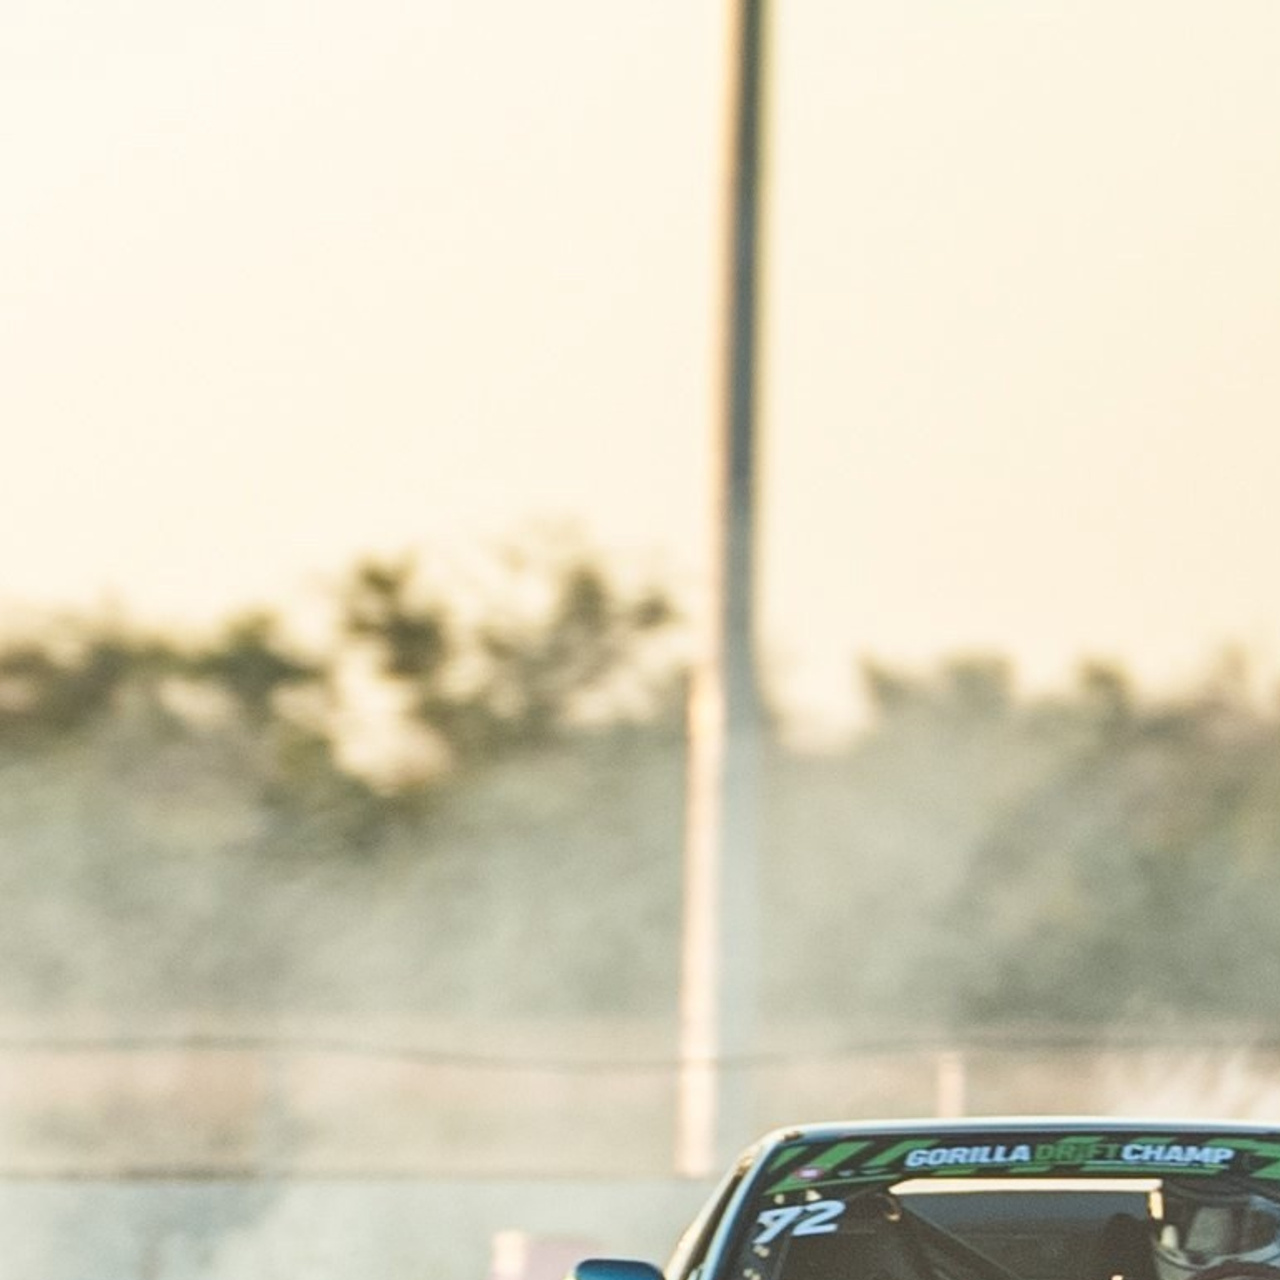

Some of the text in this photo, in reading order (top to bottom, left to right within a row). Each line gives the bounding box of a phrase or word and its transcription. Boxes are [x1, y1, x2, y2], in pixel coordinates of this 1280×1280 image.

[905, 1145, 1030, 1167] GORILLA
[1121, 1144, 1234, 1164] CHAMP
[752, 1200, 846, 1244] 92
